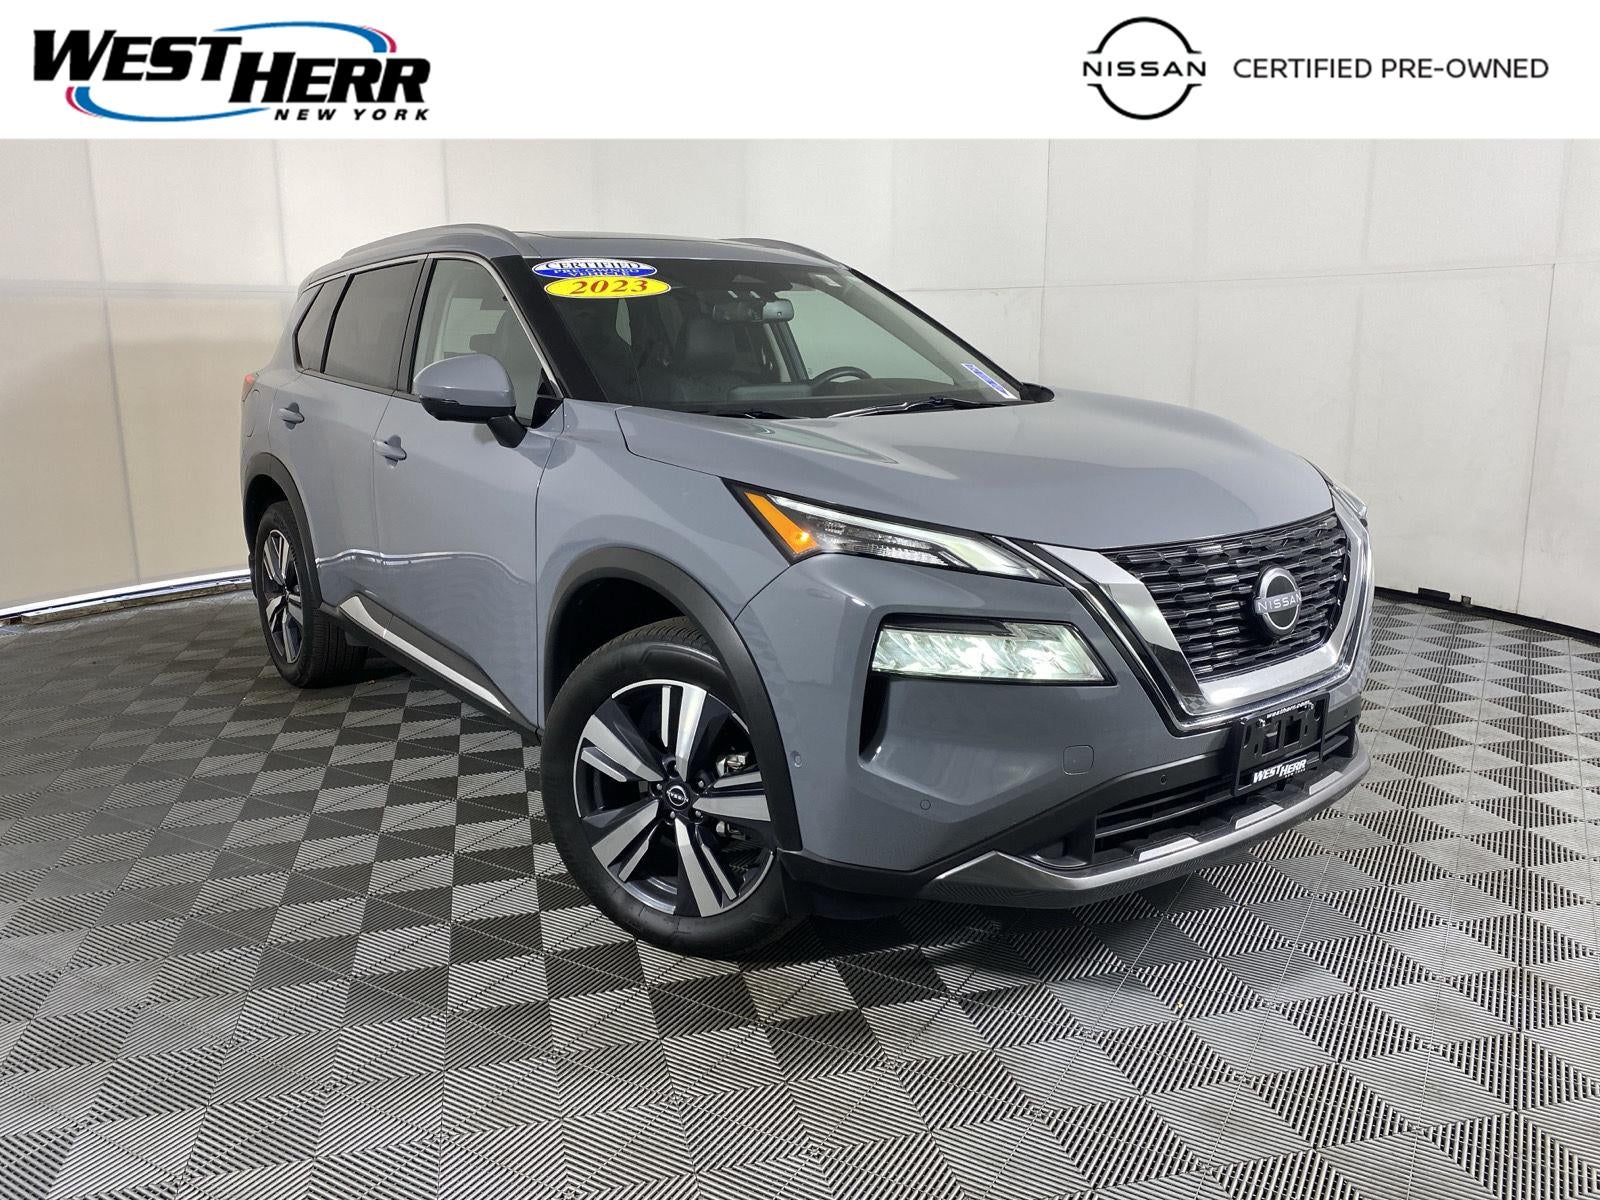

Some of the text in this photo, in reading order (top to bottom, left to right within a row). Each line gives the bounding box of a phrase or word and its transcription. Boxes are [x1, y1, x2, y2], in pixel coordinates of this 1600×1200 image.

[546, 262, 641, 270] CERTIFIED
[569, 279, 649, 295] 2023
[1257, 591, 1303, 611] NISSAN
